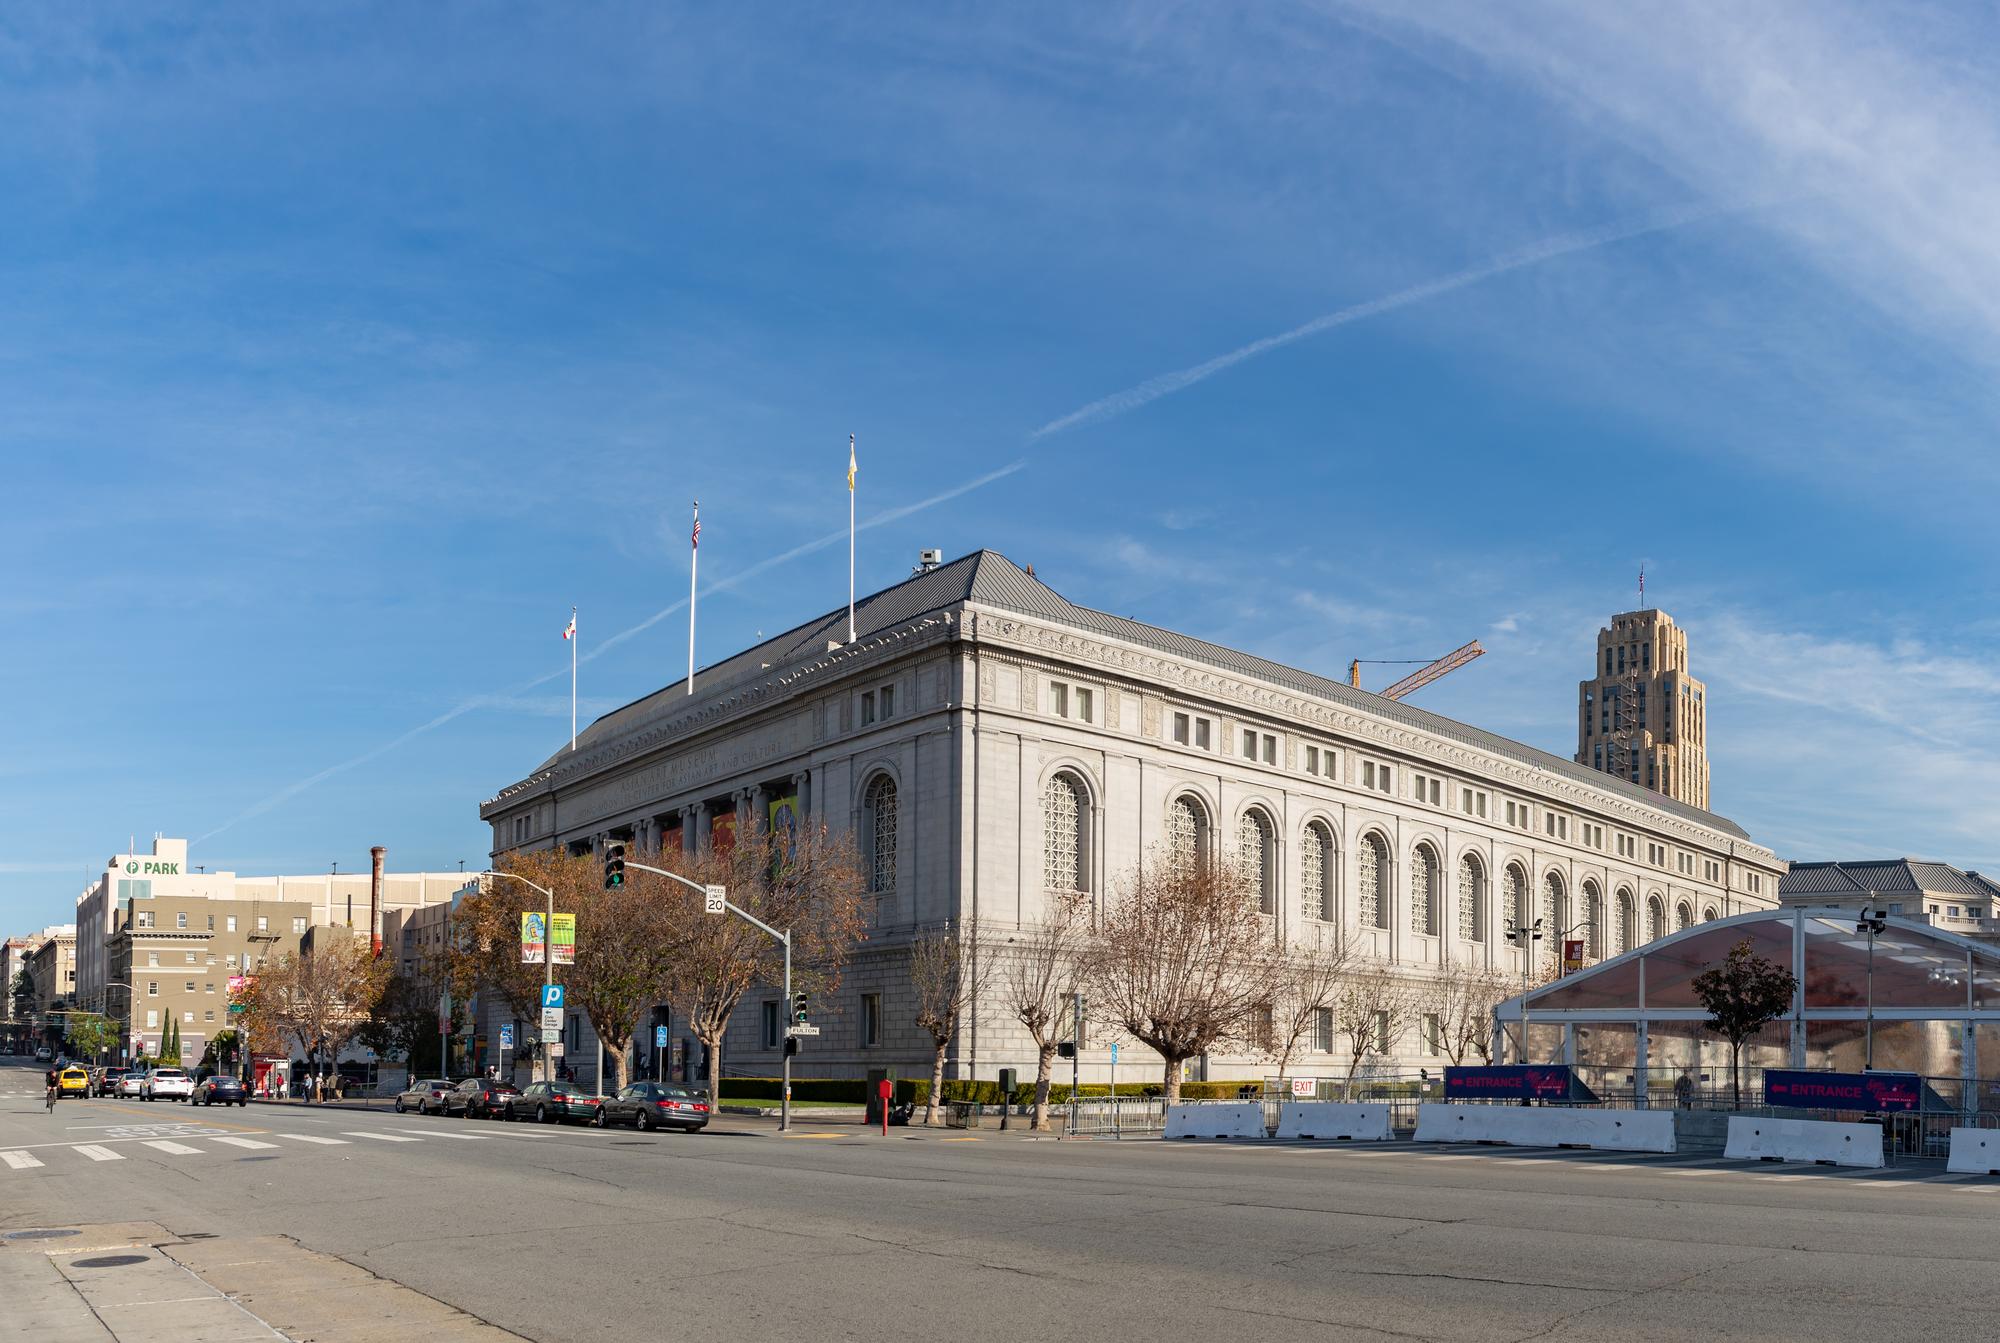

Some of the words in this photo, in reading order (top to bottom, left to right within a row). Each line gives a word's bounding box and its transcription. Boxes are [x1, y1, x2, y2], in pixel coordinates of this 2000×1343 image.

[621, 772, 649, 792] ASIAN
[671, 751, 717, 773] MUSEUM
[144, 862, 179, 875] PARK
[708, 900, 723, 910] 20
[1294, 1081, 1313, 1091] EXIT
[1466, 1077, 1522, 1087] ENTRANCE
[1791, 1084, 1863, 1098] ENTRANCE
